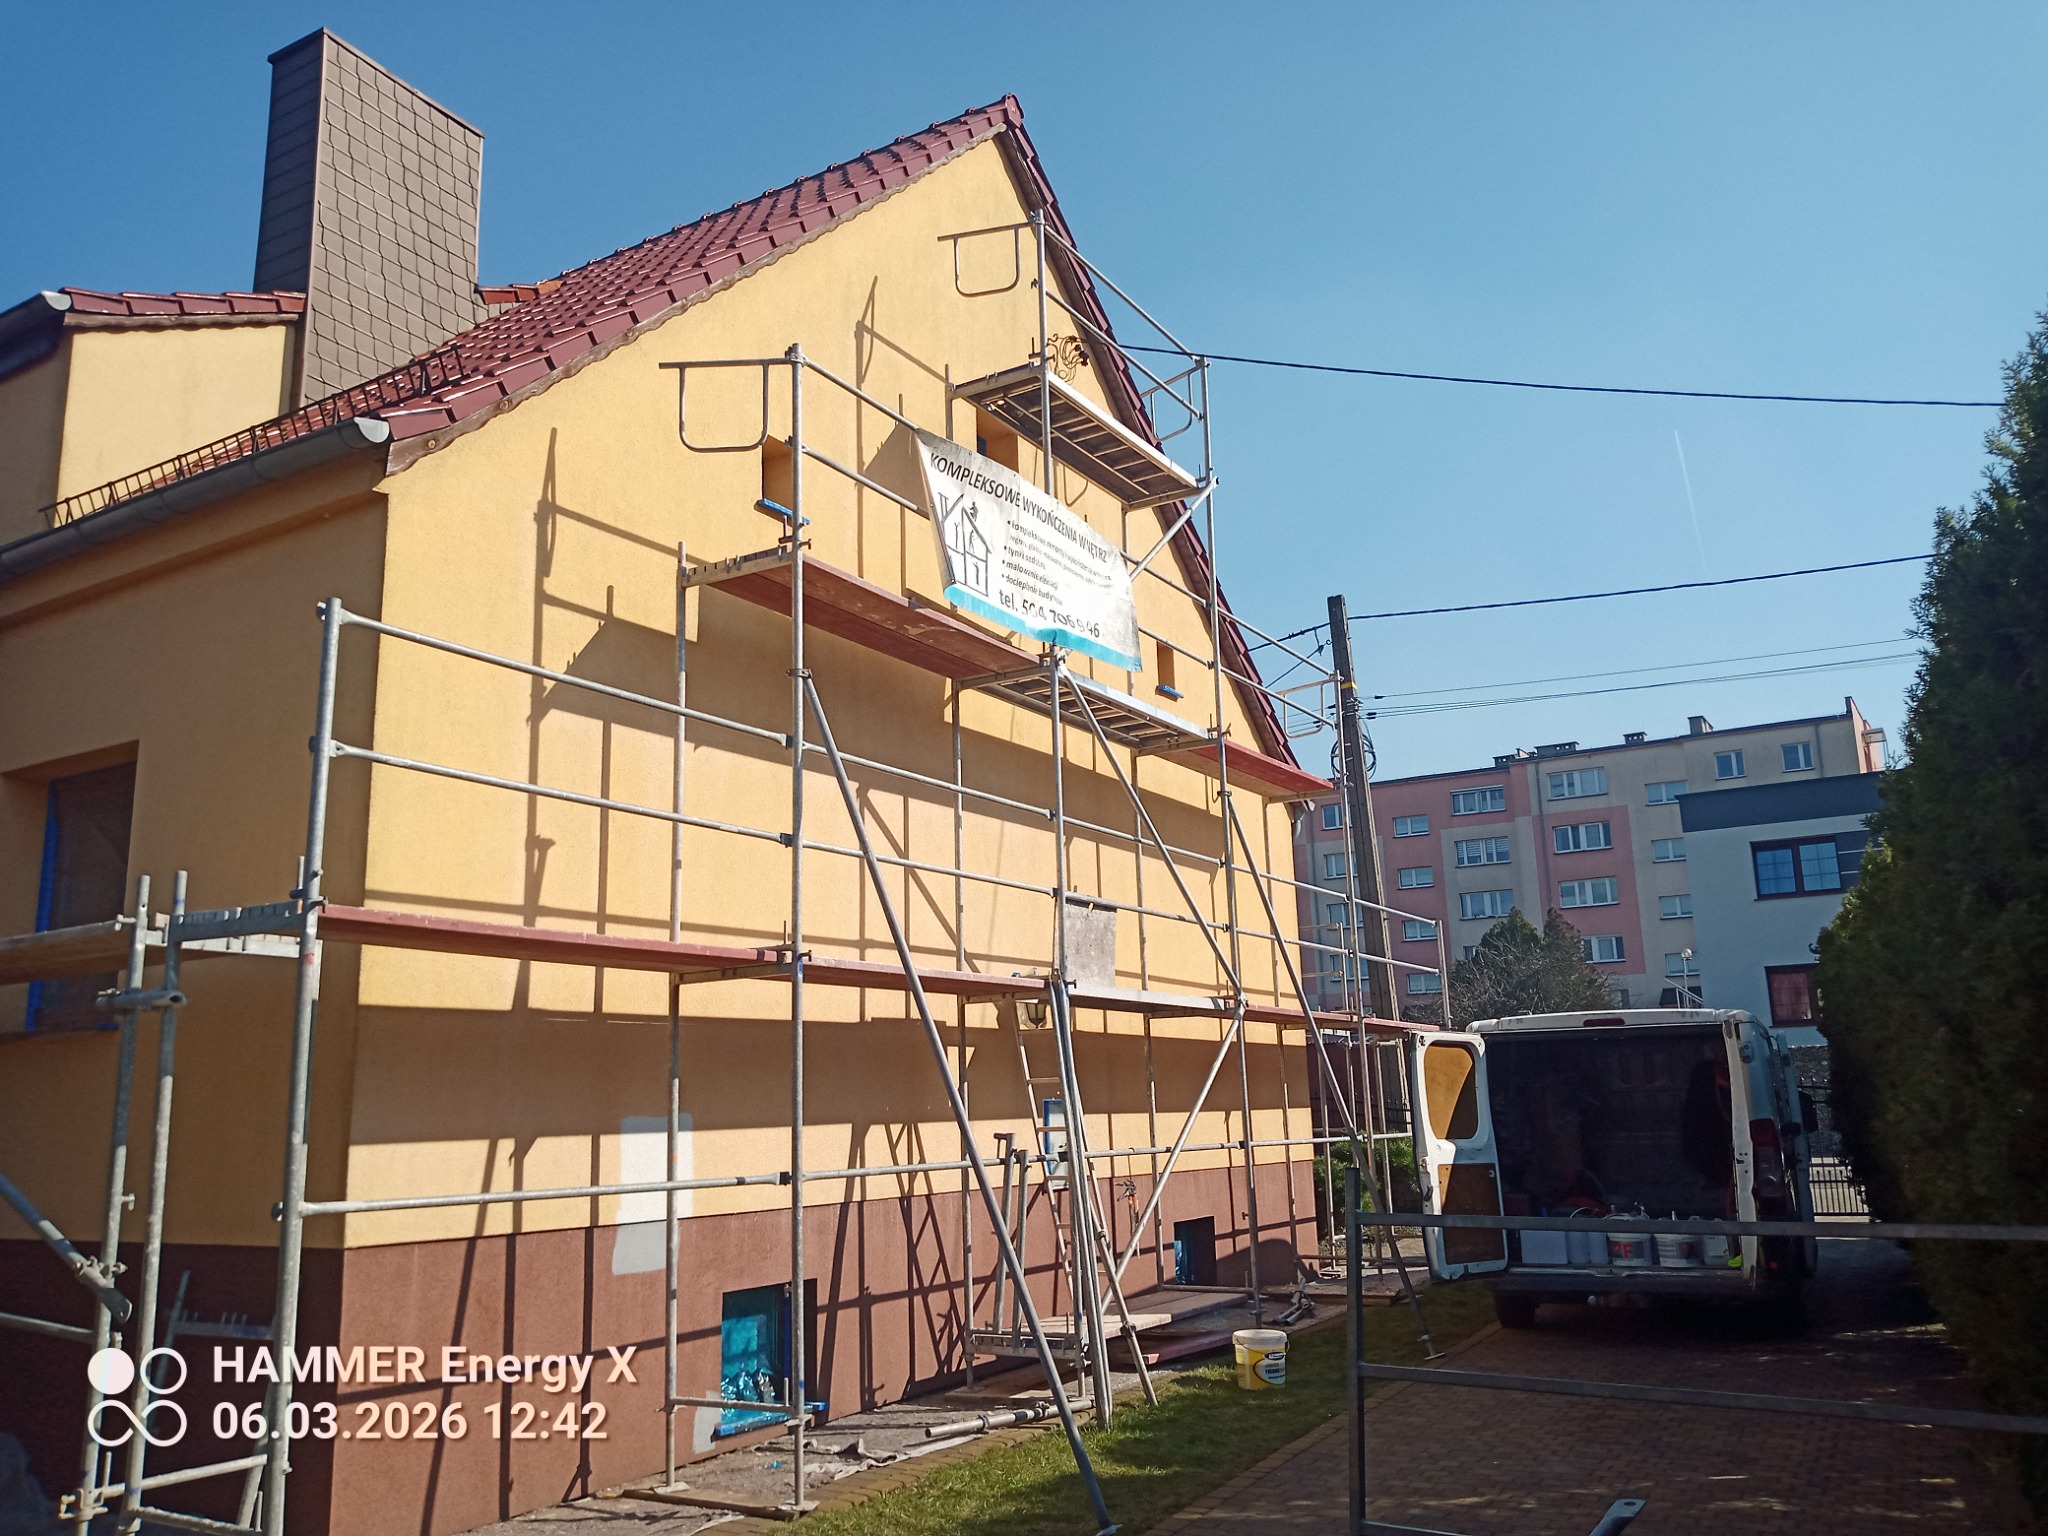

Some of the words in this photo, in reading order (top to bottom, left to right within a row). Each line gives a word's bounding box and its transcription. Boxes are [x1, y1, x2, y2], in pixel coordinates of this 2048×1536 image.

[930, 452, 1020, 508] KOMPLEKSOWE
[1022, 495, 1078, 543] WYKOŃCZENIA
[1078, 533, 1108, 564] WNĘTRZ
[998, 588, 1018, 613] tel.
[1049, 609, 1075, 629] 706
